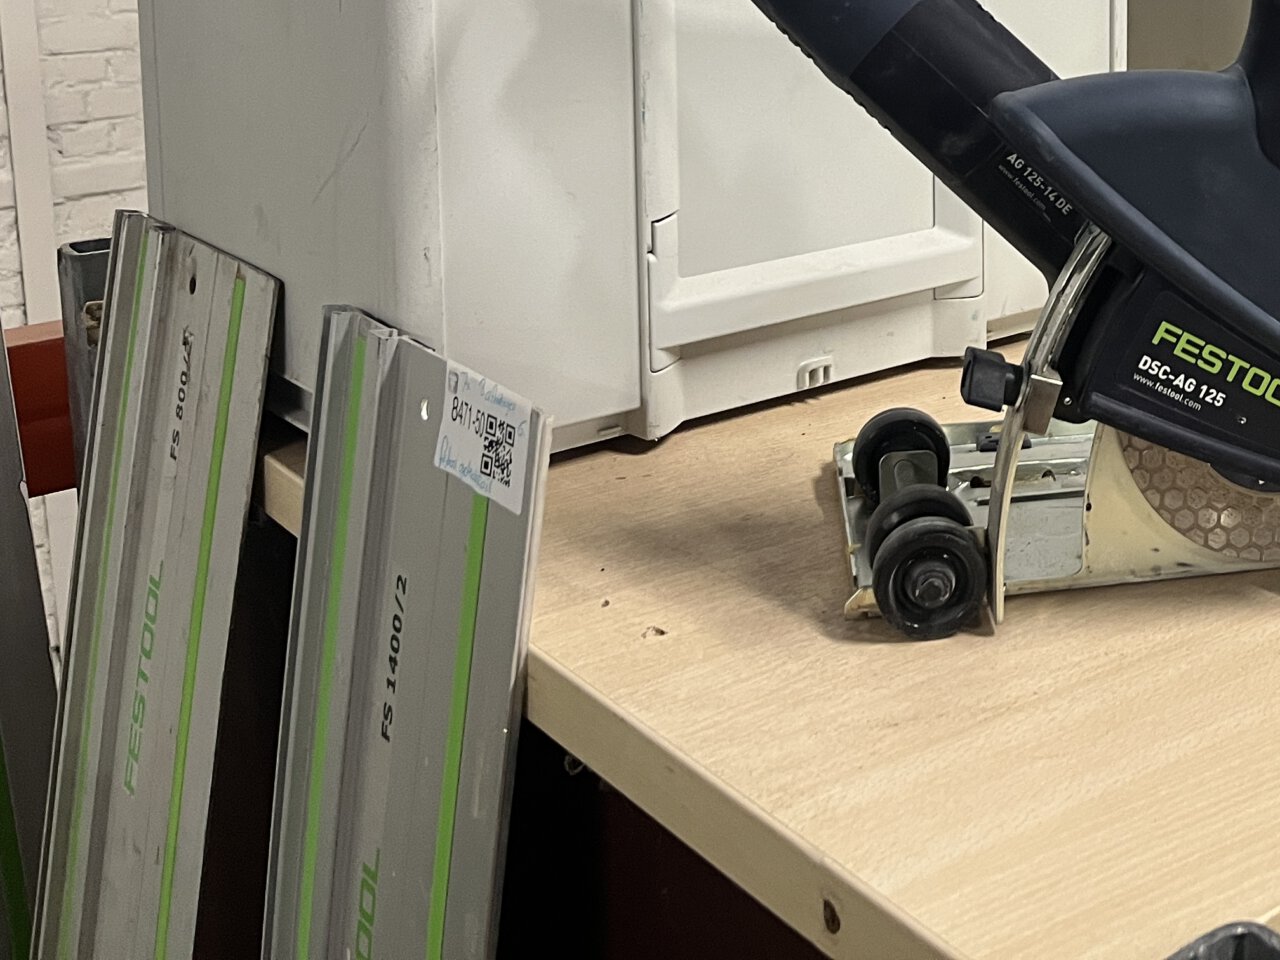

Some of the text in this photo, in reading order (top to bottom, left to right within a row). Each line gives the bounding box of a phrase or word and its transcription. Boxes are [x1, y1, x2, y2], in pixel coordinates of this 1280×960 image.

[1006, 153, 1073, 215] AG 125-14 DE
[1133, 372, 1202, 412] www.festool.com
[1137, 354, 1226, 408] DSC-AG 125
[451, 396, 486, 438] 8471-50
[169, 428, 180, 461] FS
[123, 559, 164, 797] FESTOOL
[380, 574, 408, 743] FS 1400/2
